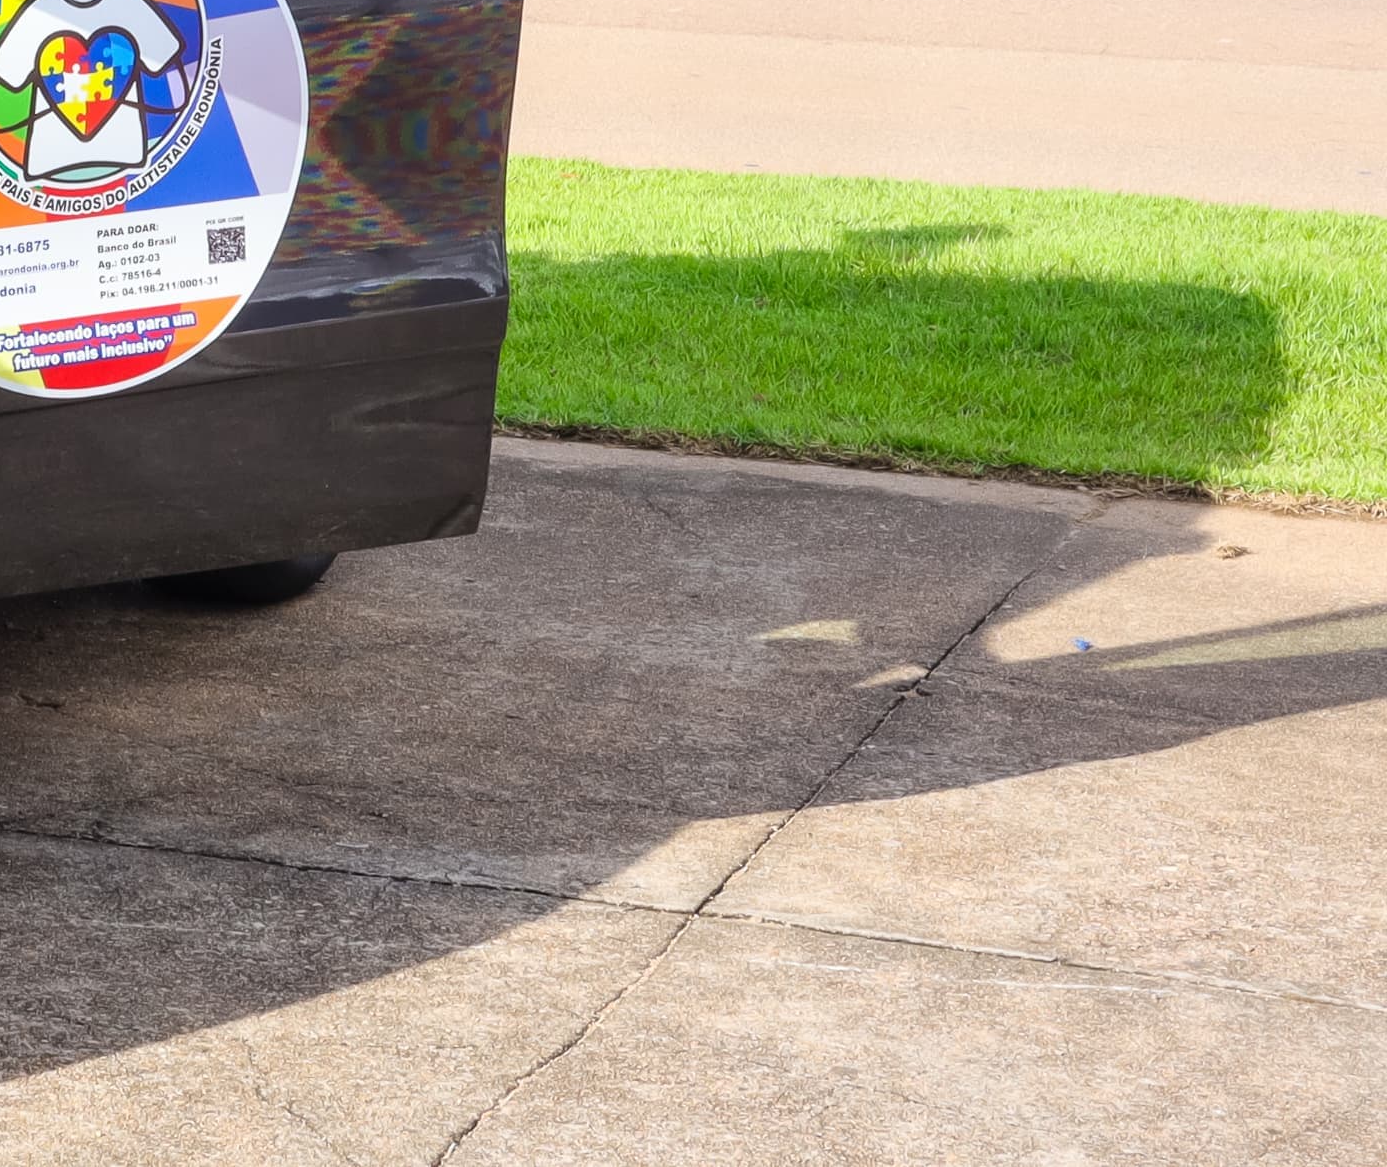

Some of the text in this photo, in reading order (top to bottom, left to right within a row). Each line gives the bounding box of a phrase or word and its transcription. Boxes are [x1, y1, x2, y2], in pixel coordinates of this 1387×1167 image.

[1, 178, 31, 203] PAIS
[33, 194, 44, 208] E
[45, 197, 101, 213] AMIGOS
[105, 188, 126, 207] DO
[129, 146, 183, 196] AUTISTA
[179, 124, 198, 147] DE
[193, 37, 222, 125] RONDÔNIA
[97, 223, 159, 238] PARA DOAR:
[97, 235, 177, 254] Banco do Brasil
[120, 253, 161, 266] 0102-03
[122, 267, 162, 281] 78516-4
[100, 289, 119, 299] Pix:
[95, 321, 134, 340] laços
[137, 316, 170, 334] para
[173, 313, 196, 327] um
[13, 352, 61, 371] futuro
[63, 346, 99, 364] mais
